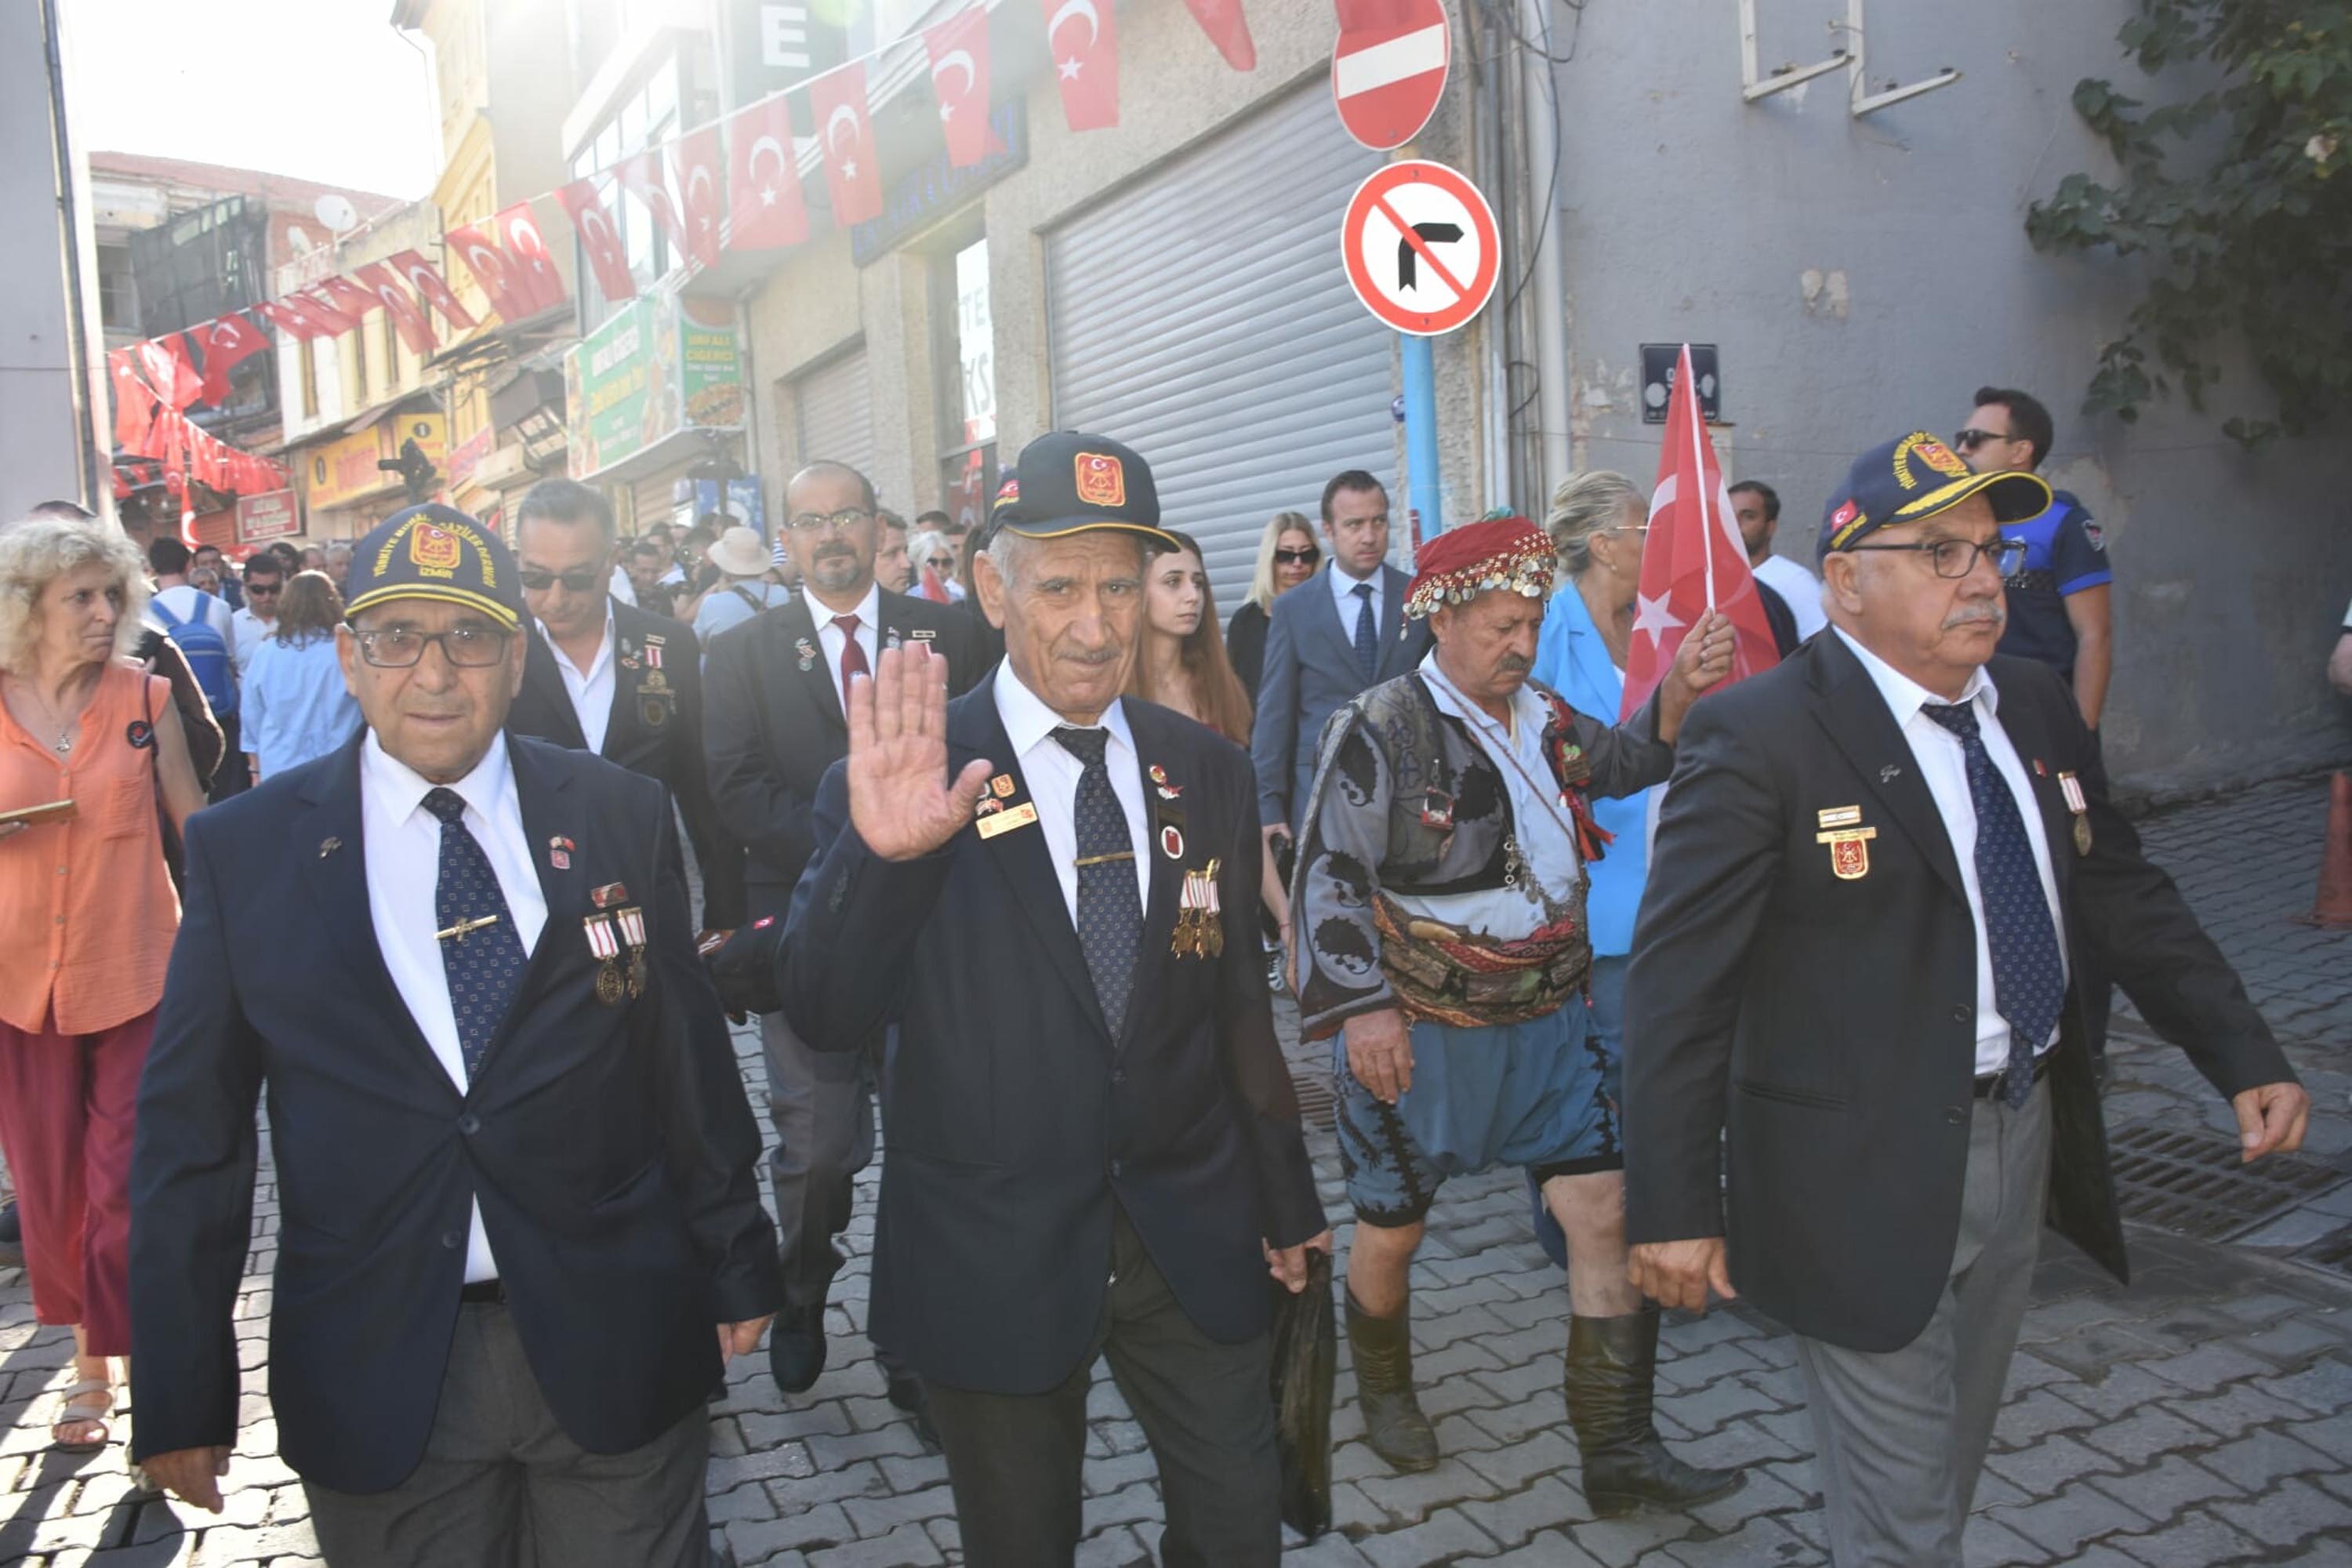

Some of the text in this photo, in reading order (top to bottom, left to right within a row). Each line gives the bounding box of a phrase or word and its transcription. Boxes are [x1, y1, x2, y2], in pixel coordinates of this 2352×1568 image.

[372, 535, 400, 577] TÜRKİYE
[394, 513, 431, 538] MUHARİ
[419, 564, 454, 579] İZMİR
